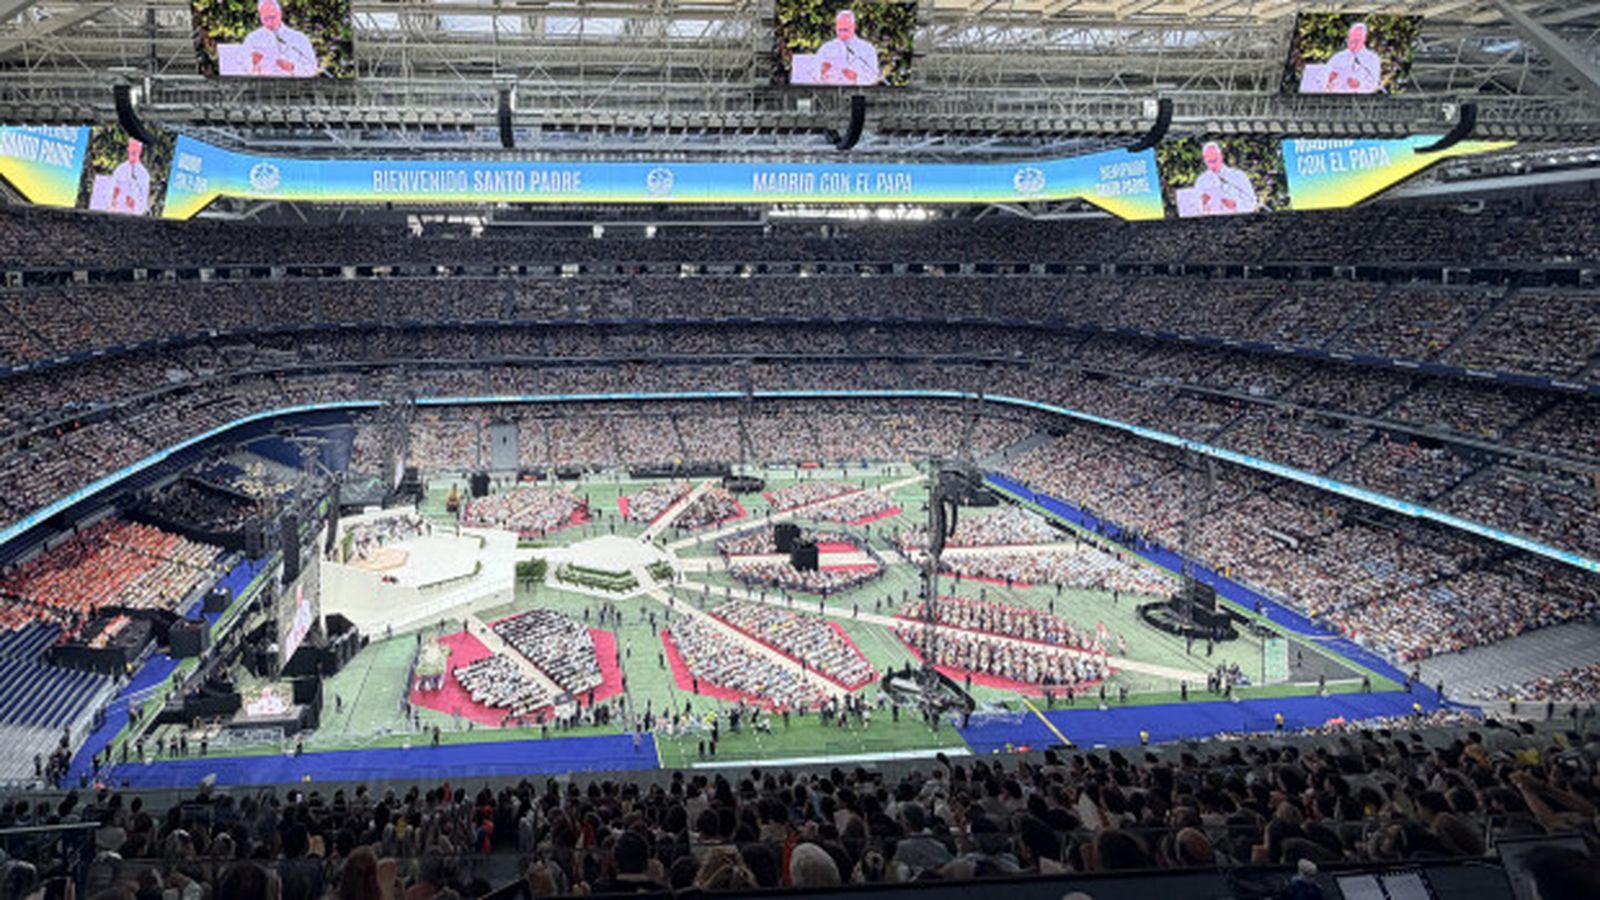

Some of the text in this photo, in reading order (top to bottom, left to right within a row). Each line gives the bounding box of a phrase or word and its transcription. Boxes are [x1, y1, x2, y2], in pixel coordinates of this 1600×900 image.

[1297, 145, 1392, 176] CON EL PAPA
[372, 169, 582, 193] BIENVENIDO SANTO PADRE
[752, 171, 913, 194] MADRID CON EL PAPA
